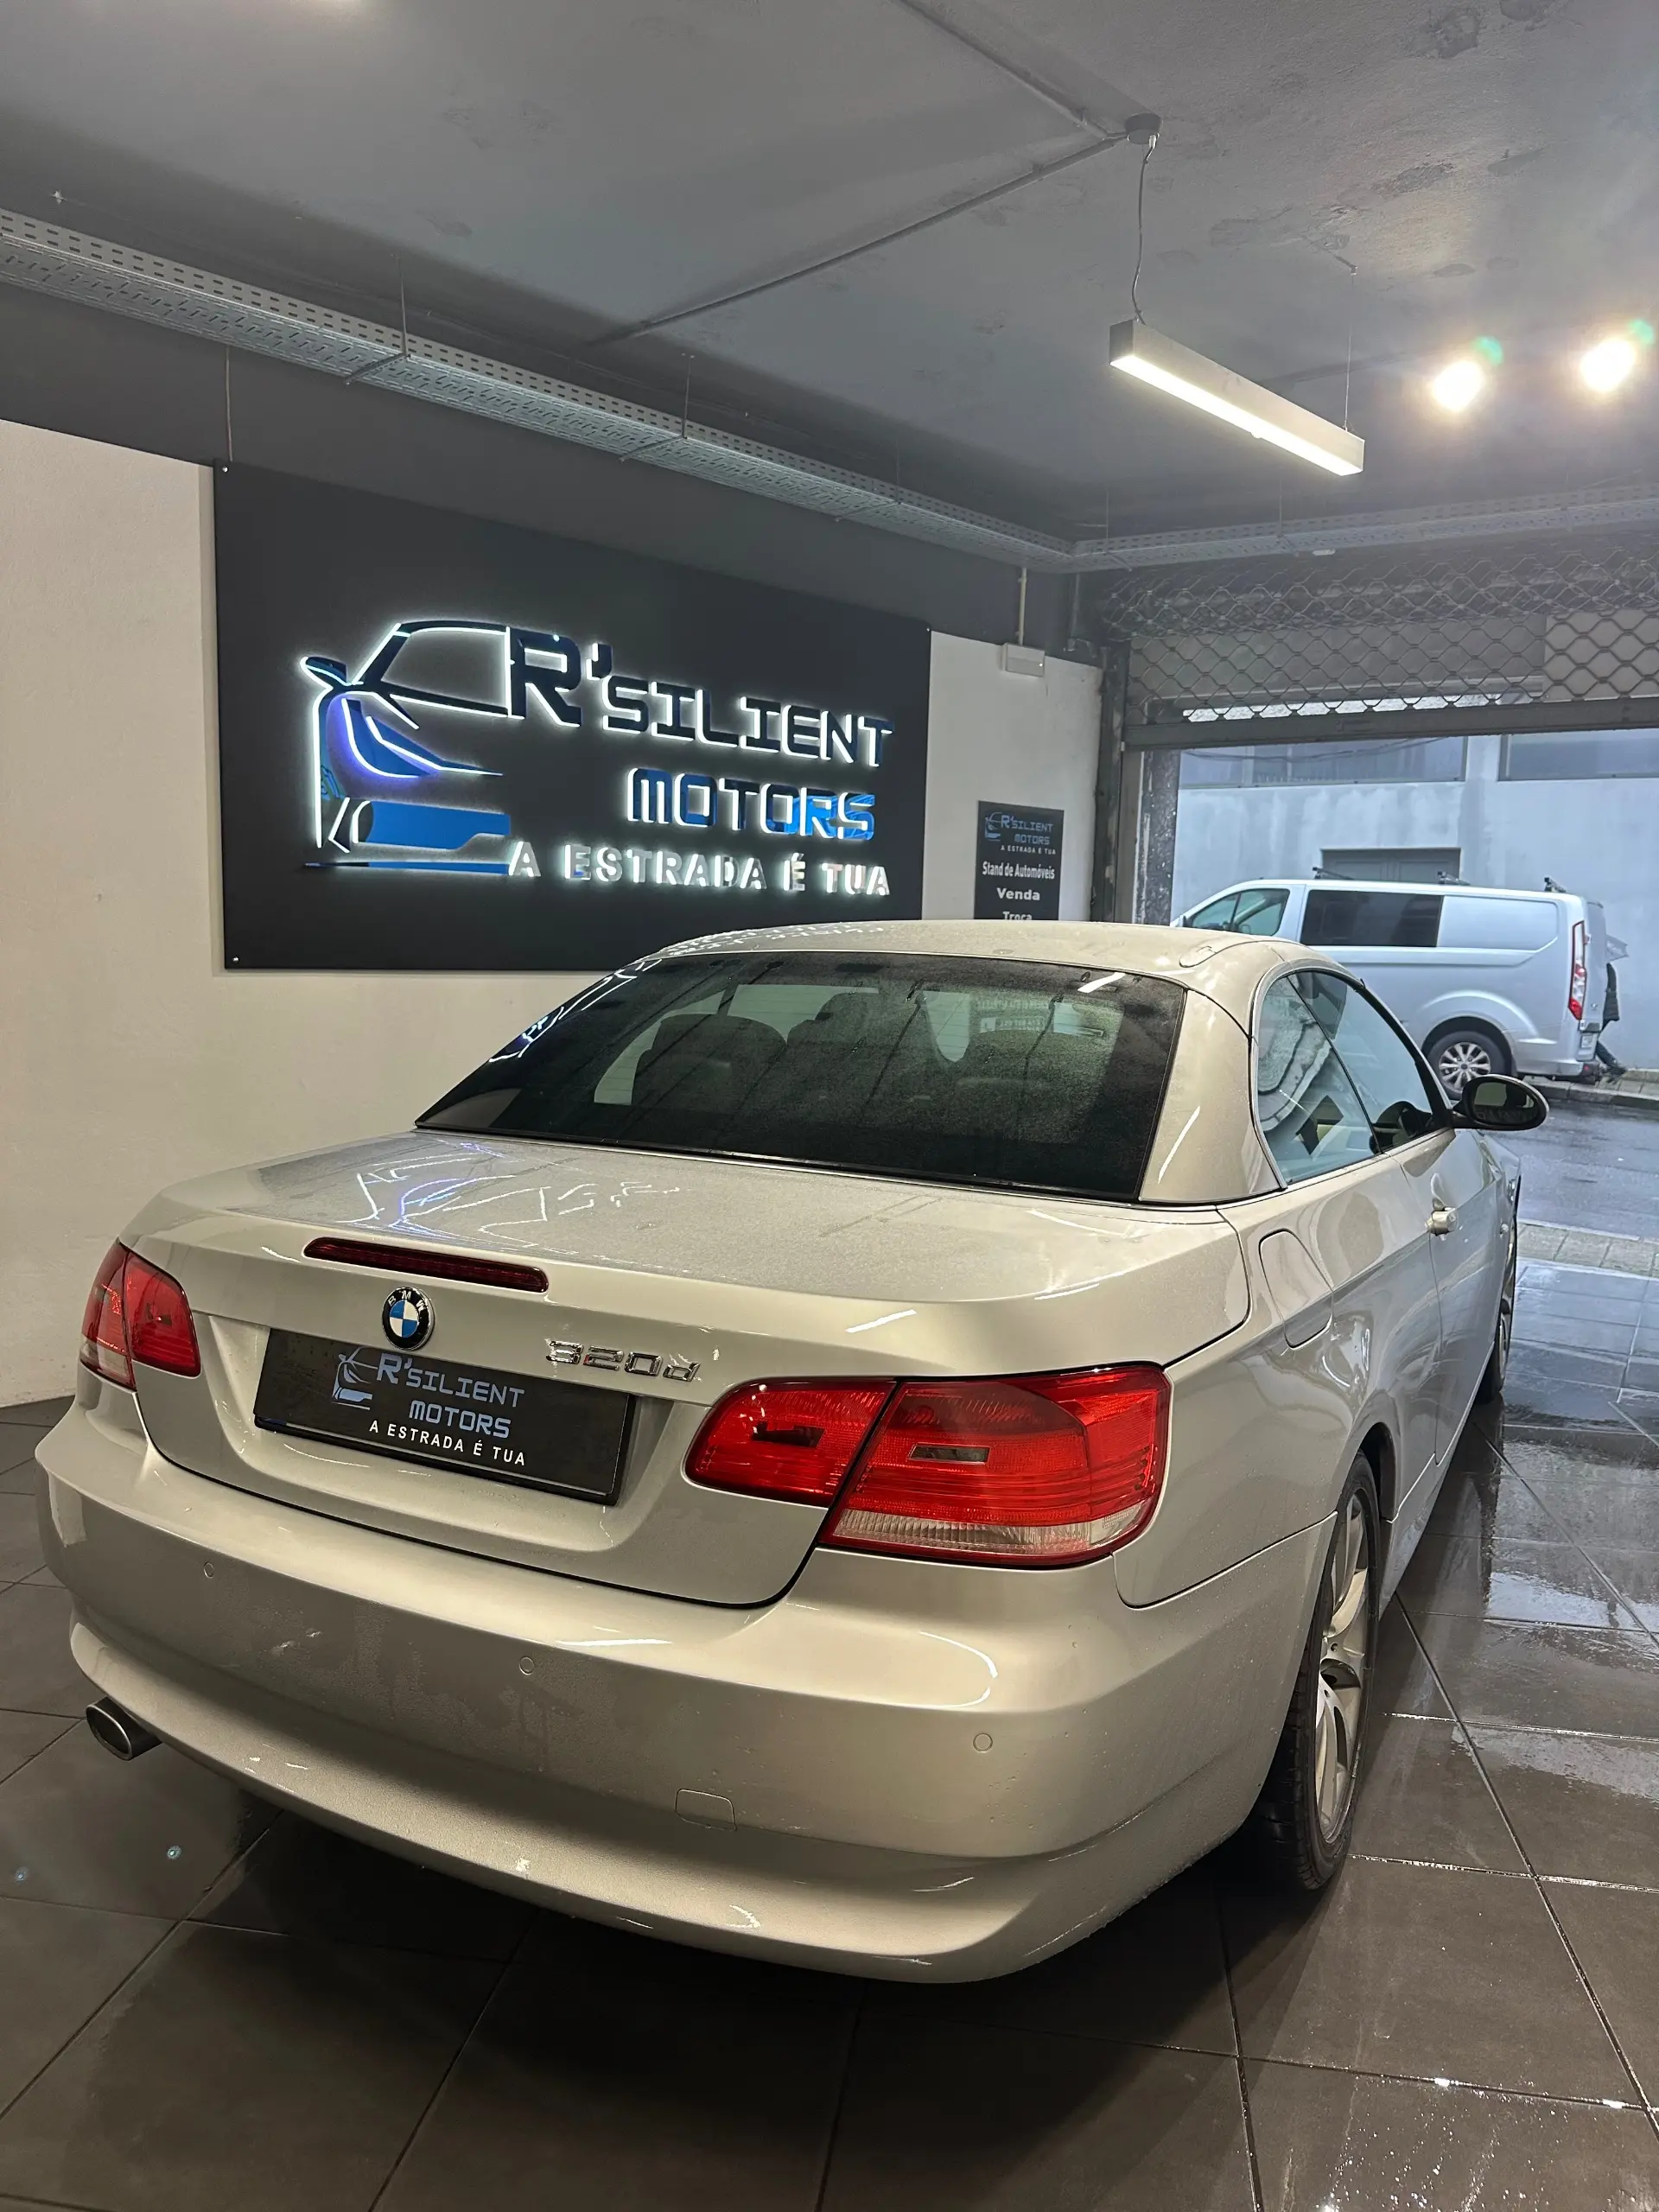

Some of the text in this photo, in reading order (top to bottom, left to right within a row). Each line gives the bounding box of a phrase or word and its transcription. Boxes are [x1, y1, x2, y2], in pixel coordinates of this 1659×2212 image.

[511, 626, 894, 767] R'SILIENT
[627, 767, 875, 840] MOTORS
[1007, 845, 1036, 854] ESTRADA
[1014, 834, 1050, 845] MOTORS
[509, 842, 890, 896] A ESTRADA É TUA
[982, 861, 1056, 880] Stand de Automóveis
[996, 887, 1040, 900] Venda
[387, 1289, 426, 1313] BMW
[377, 1352, 525, 1408] R'SILIENT
[546, 1340, 702, 1382] 320d
[409, 1400, 512, 1440] MOTORS
[369, 1420, 526, 1466] A ESTRADA É TUA
